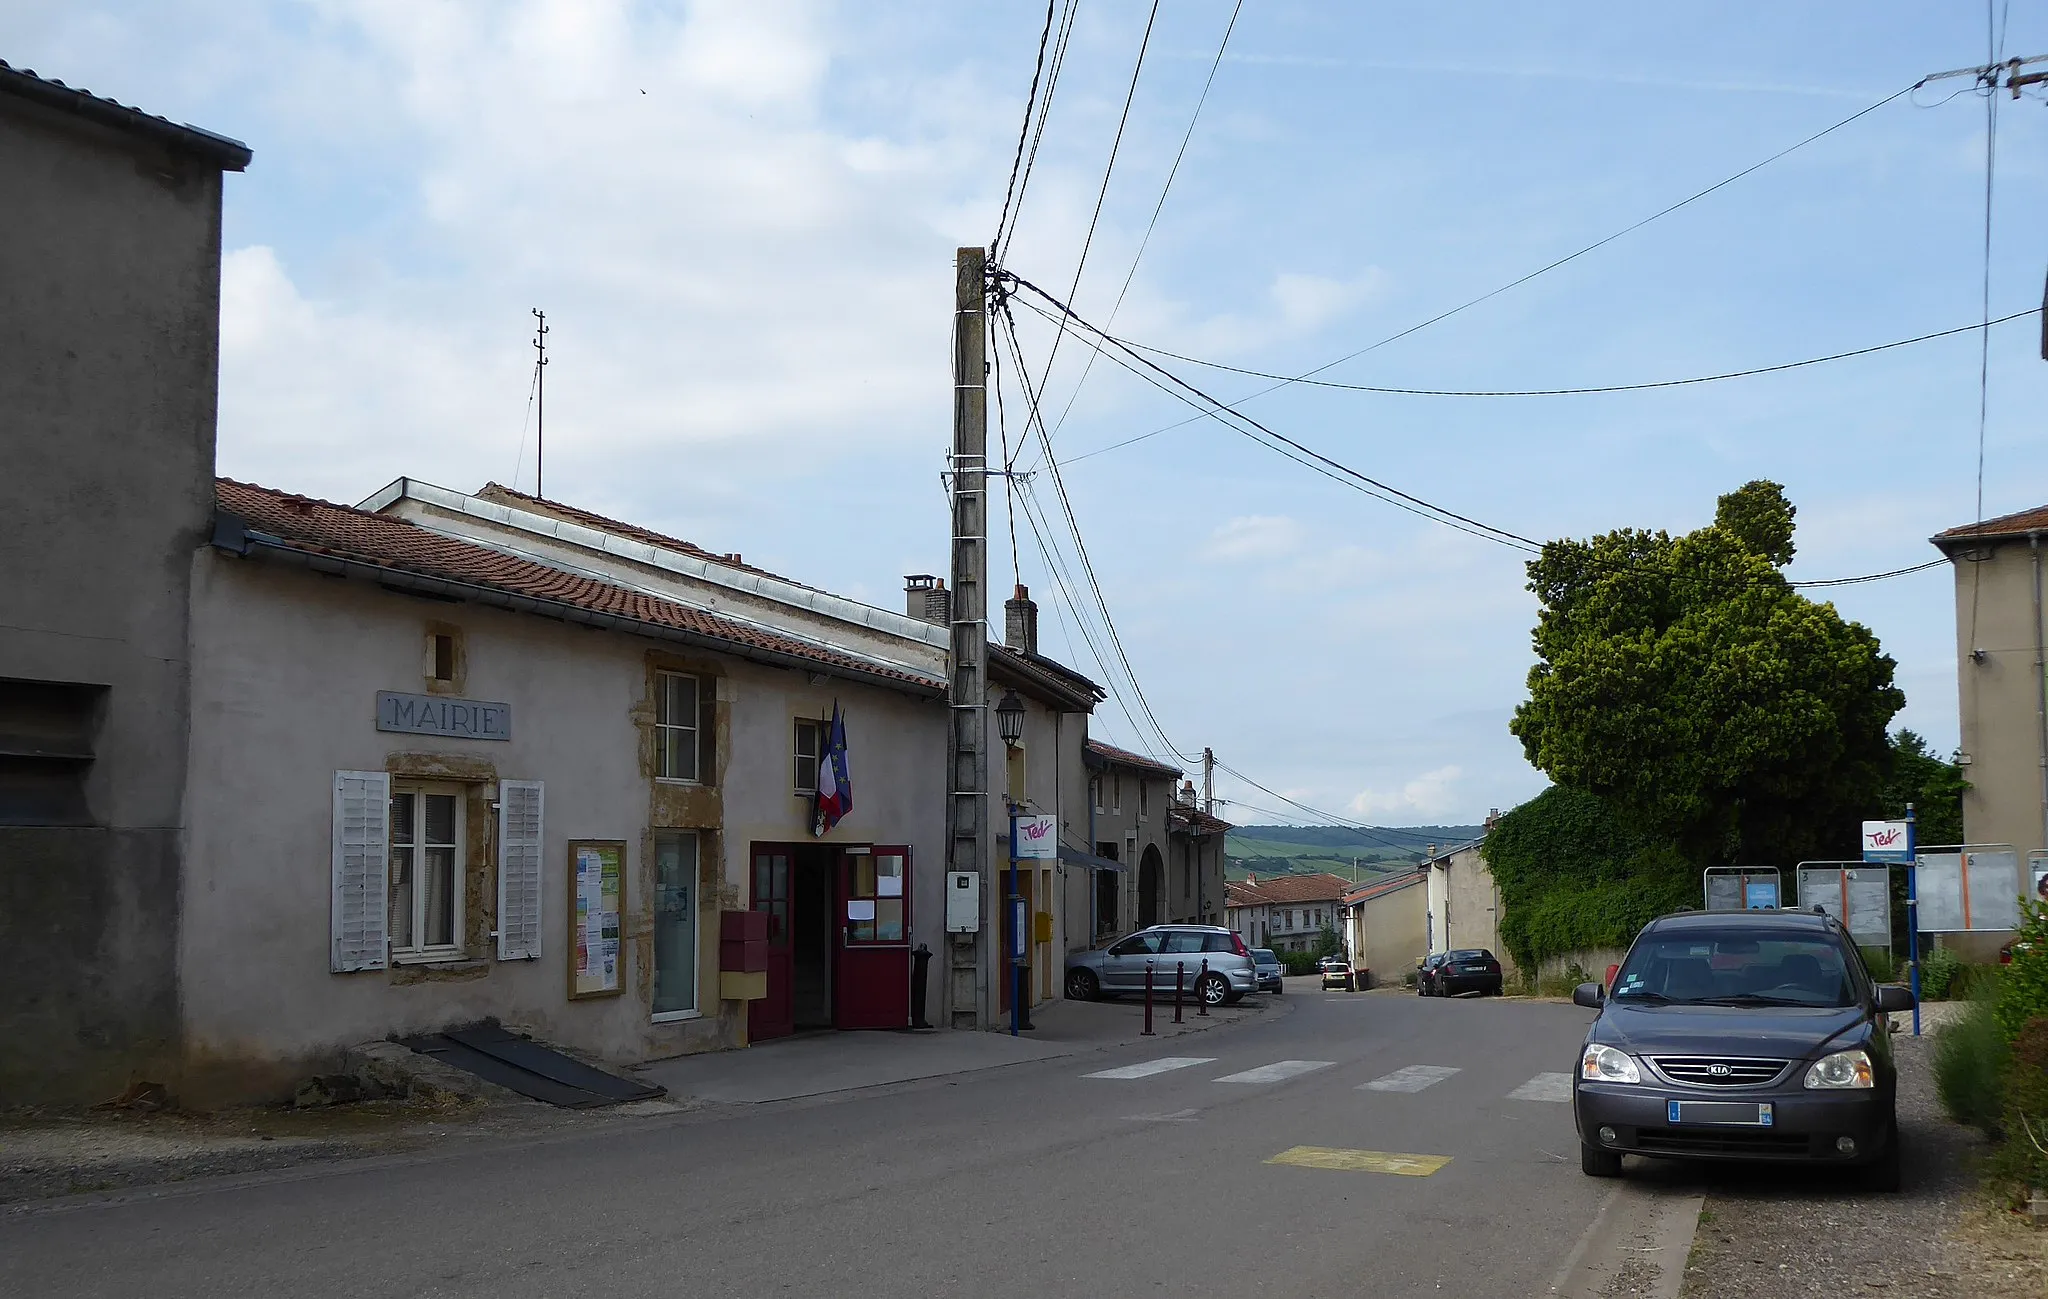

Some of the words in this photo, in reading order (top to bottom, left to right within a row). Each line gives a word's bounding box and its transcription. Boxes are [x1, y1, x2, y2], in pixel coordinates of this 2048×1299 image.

[392, 698, 498, 735] MAIRIE
[1917, 856, 1925, 868] 5
[1967, 855, 1974, 866] 6
[1803, 872, 1809, 882] 3
[1710, 1066, 1728, 1074] KIA
